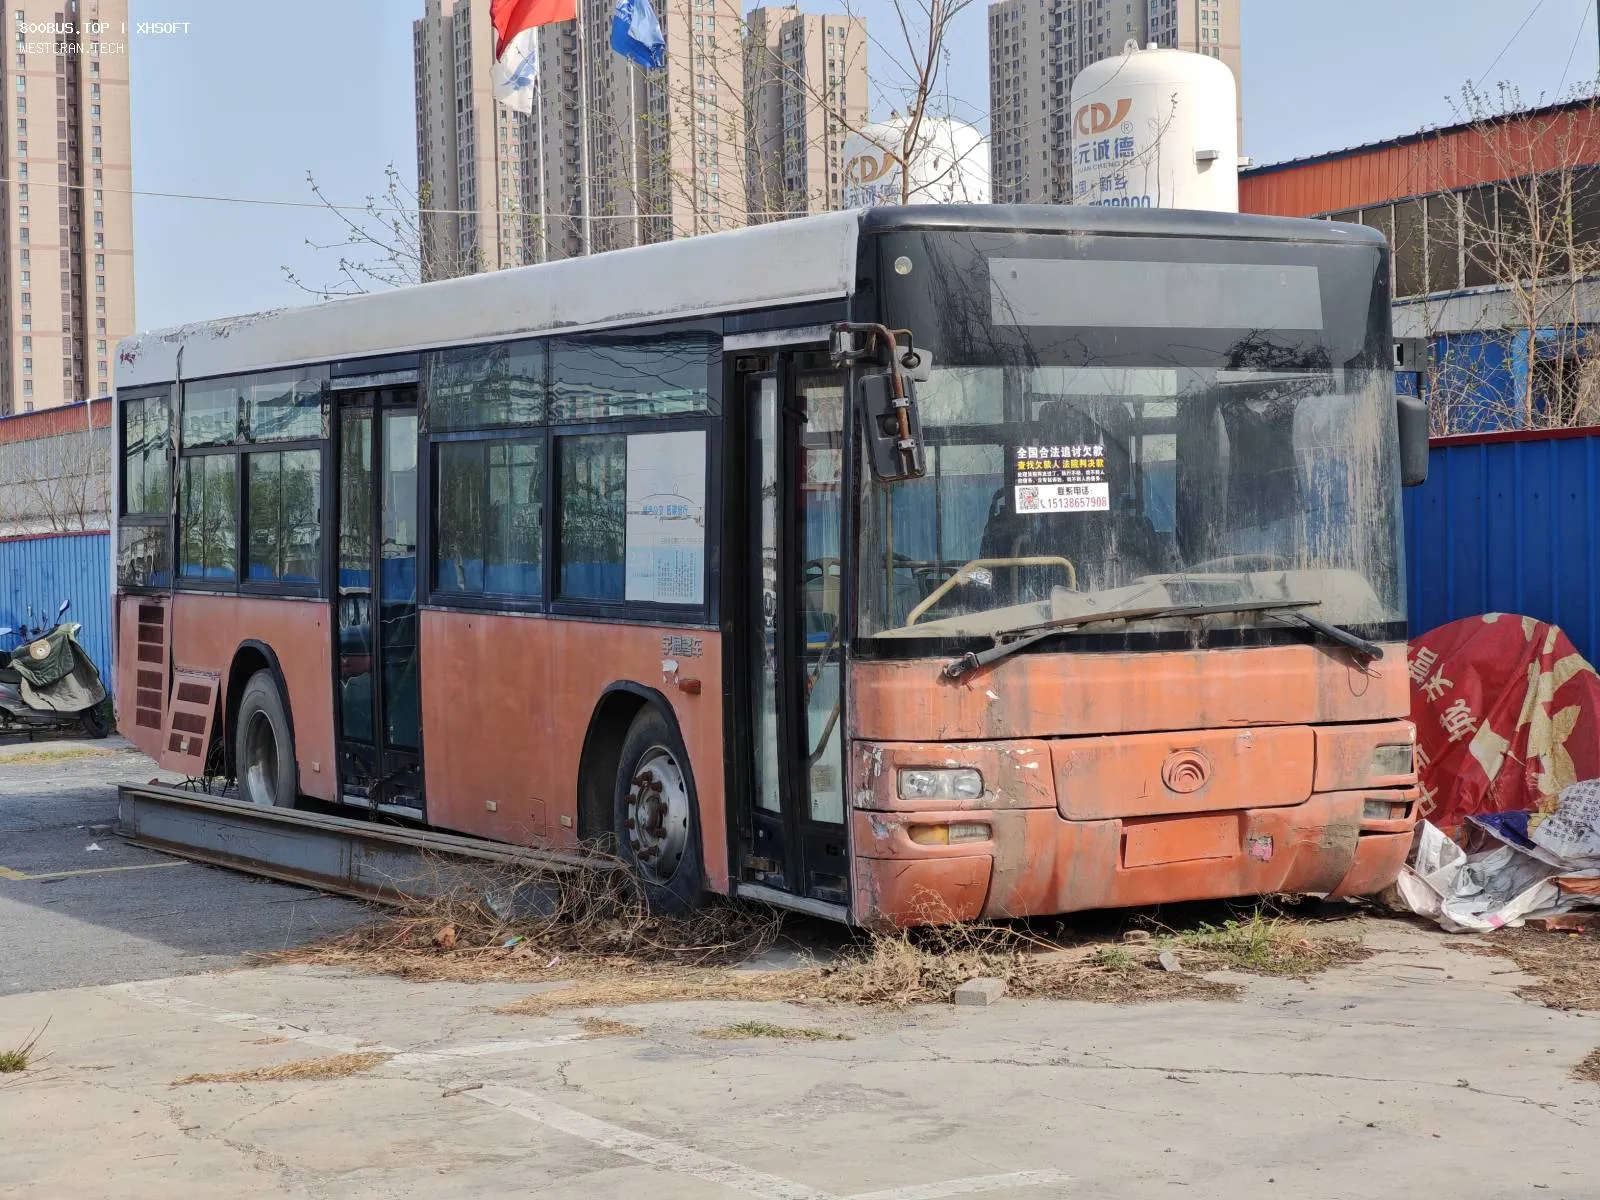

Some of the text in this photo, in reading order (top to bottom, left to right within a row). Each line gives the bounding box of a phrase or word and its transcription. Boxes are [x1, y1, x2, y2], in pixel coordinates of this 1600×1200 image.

[1017, 446, 1104, 459] 全国合法追讨欠款
[1017, 460, 1060, 470] 查找欠款人
[1048, 497, 1107, 509] 15138657908
